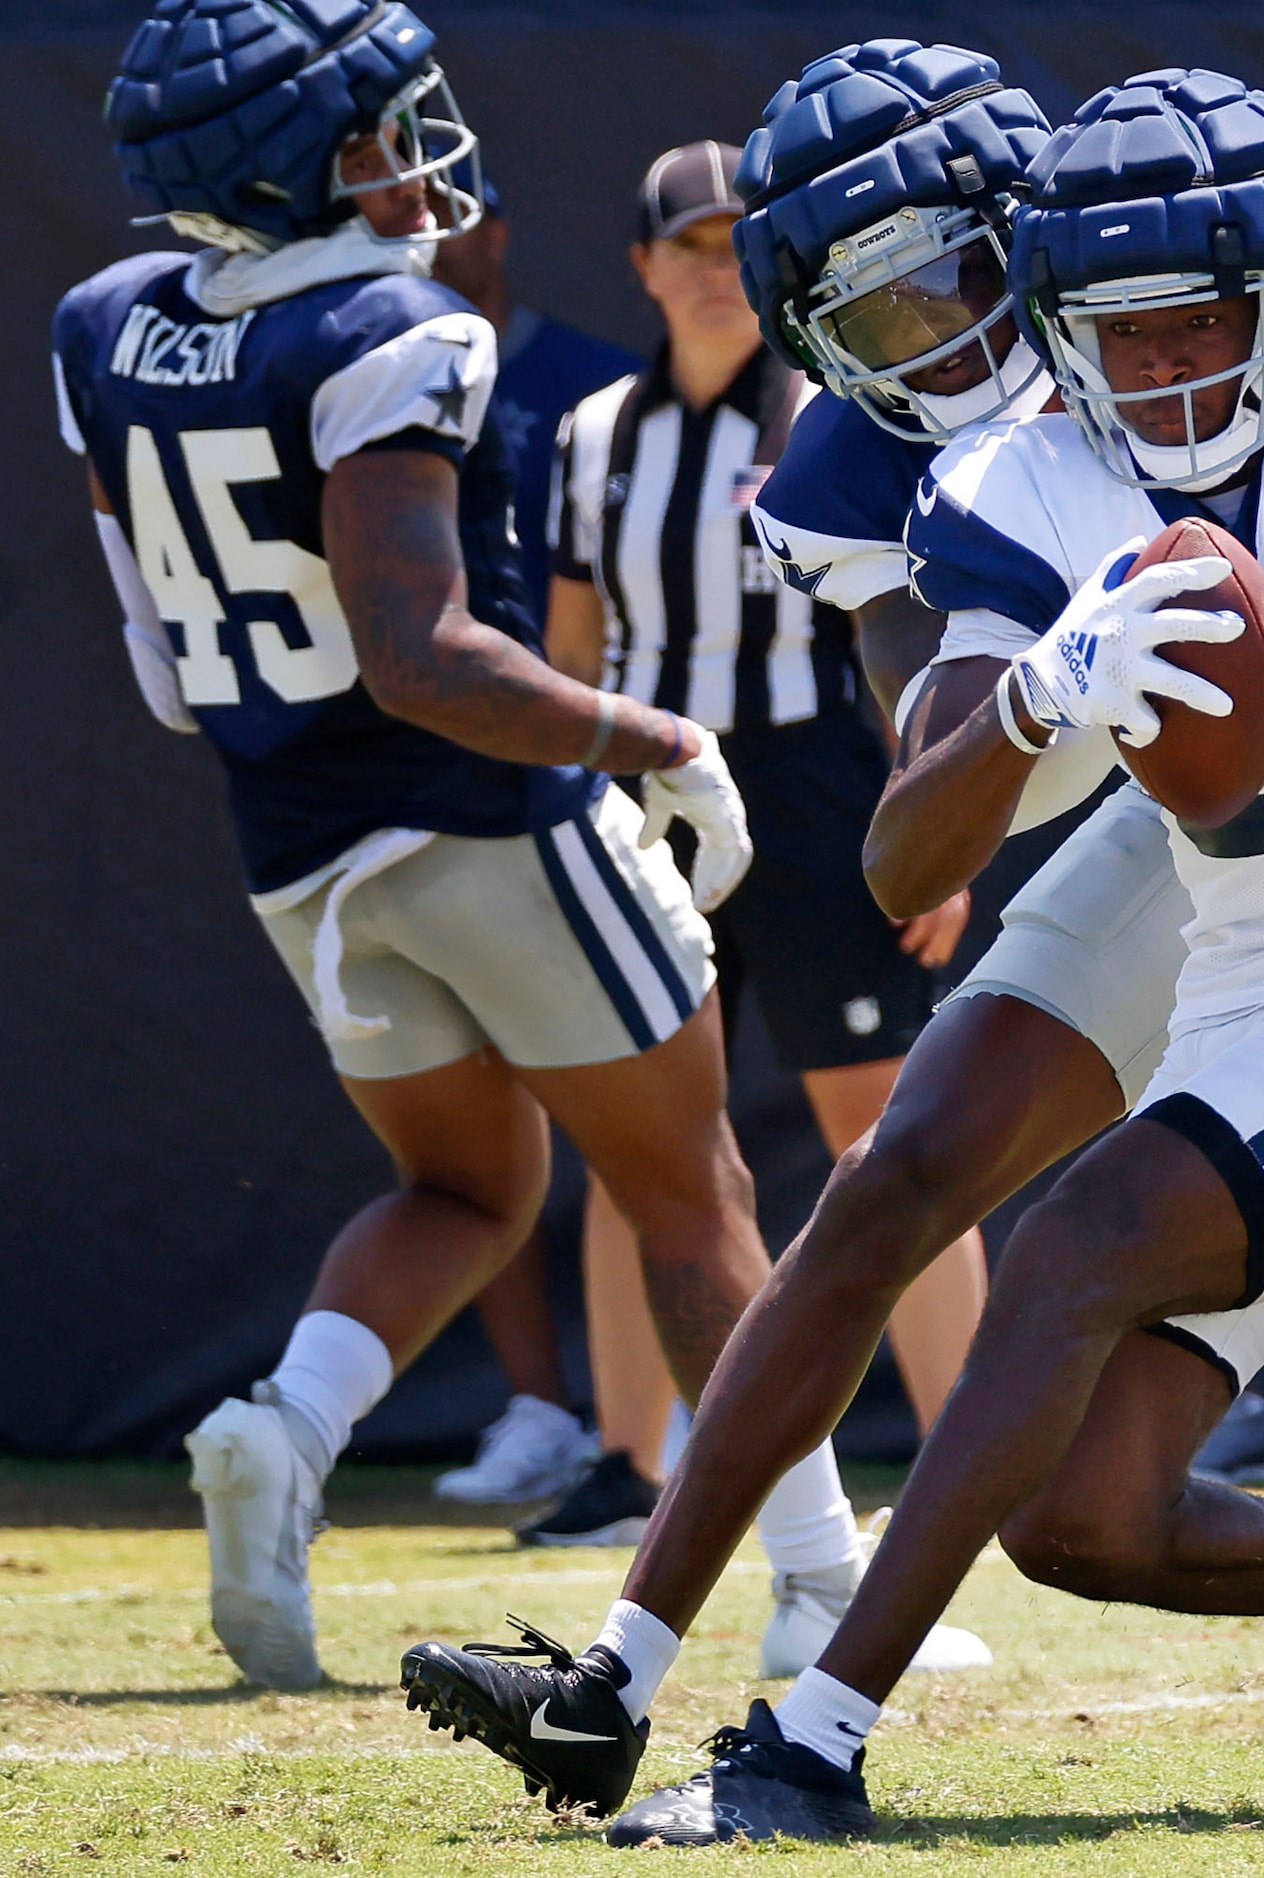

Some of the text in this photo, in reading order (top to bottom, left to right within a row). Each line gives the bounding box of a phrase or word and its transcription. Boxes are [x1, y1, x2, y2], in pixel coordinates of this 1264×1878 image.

[857, 225, 896, 249] COWBOYS
[127, 424, 360, 706] 45
[1056, 634, 1089, 695] adidas
